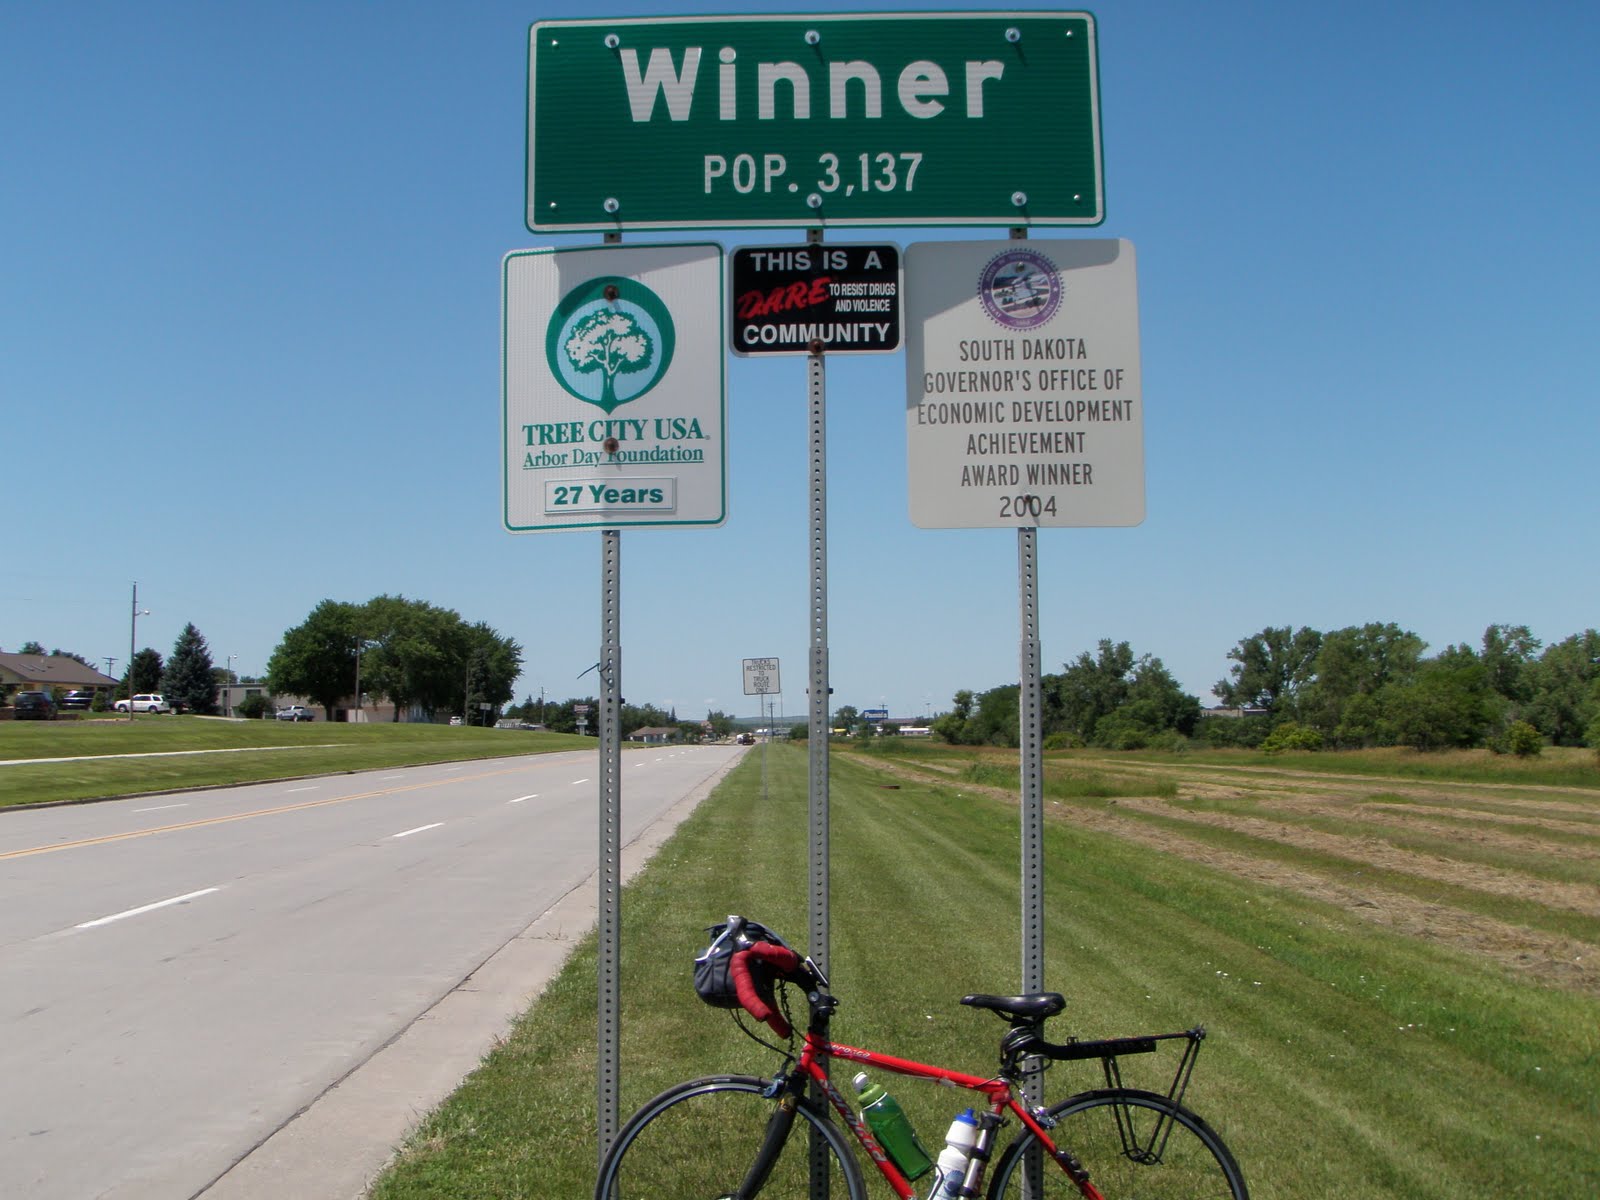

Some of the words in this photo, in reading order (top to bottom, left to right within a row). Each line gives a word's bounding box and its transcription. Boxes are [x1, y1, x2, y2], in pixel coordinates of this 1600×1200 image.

[619, 46, 1005, 123] Winner
[704, 153, 798, 195] POP.
[816, 152, 924, 197] 3,137
[750, 251, 812, 272] THIS
[823, 250, 848, 270] IS
[863, 250, 883, 270] A
[829, 283, 841, 296] TO
[841, 283, 868, 296] RESIST
[869, 282, 896, 296] DRUGS
[835, 299, 852, 312] AND
[852, 299, 891, 312] VIOLENCE
[743, 322, 891, 345] COMMUNITY
[959, 339, 1015, 362] SOUTH
[1022, 338, 1087, 360] DAKOTA
[924, 370, 1031, 394] GOVERNOR'S
[1038, 369, 1097, 392] OFFICE
[1104, 368, 1125, 390] OF
[917, 401, 1005, 425] ECONOMIC
[1012, 400, 1133, 423] DEVELOPMENT
[522, 421, 584, 446] TREE
[588, 418, 649, 442] CITY
[966, 432, 1086, 456] ACHIEVEMENT
[523, 448, 568, 468] Arbor
[573, 448, 602, 468] Day
[961, 464, 1020, 487] AWARD
[1026, 463, 1094, 486] WINNER
[553, 486, 584, 506] 27
[589, 484, 664, 505] Years
[999, 495, 1058, 518] 2004
